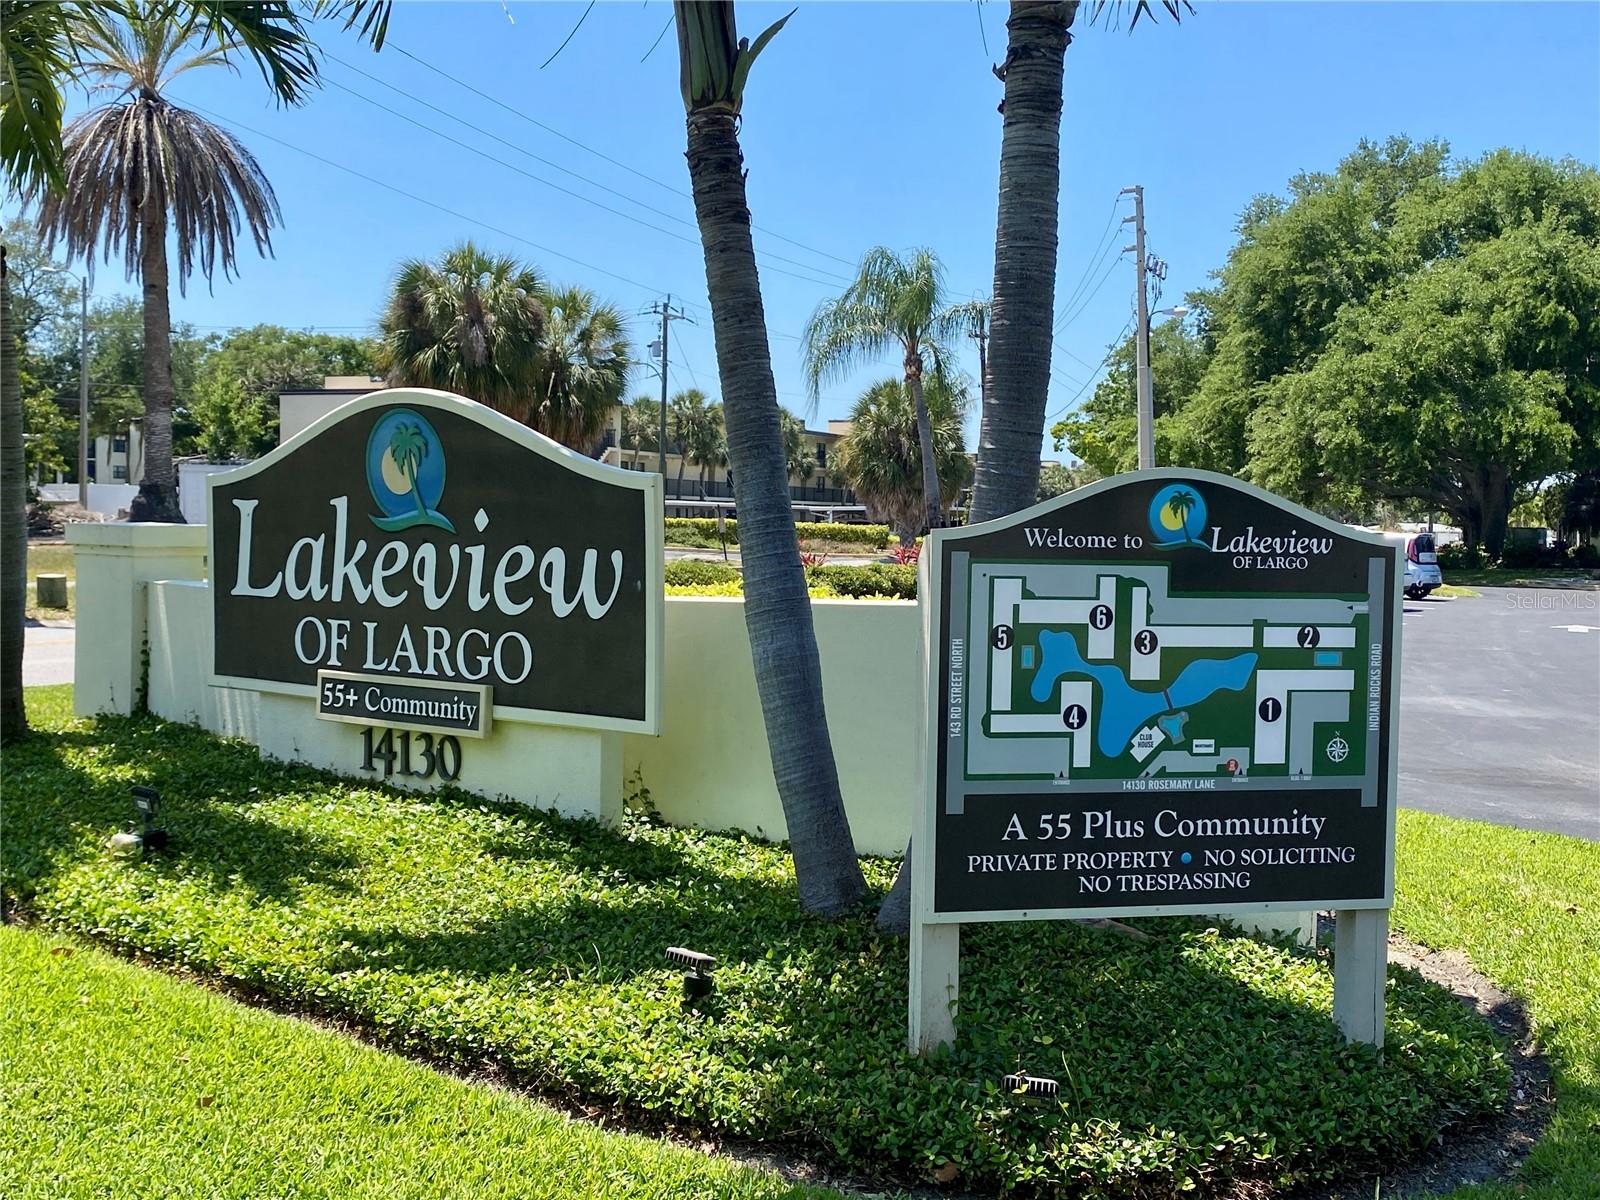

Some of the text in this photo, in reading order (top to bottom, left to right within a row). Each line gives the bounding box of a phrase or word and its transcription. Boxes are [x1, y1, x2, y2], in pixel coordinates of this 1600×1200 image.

[1024, 527, 1143, 550] Welcome to
[1210, 526, 1334, 555] Lakeview
[231, 495, 624, 619] Lakeview
[1232, 555, 1309, 570] OF LARGO
[1096, 606, 1107, 628] 6
[997, 627, 1007, 648] 5
[1140, 632, 1151, 653] 3
[1303, 626, 1314, 648] 2
[294, 616, 533, 685] OF LARGO
[950, 639, 963, 738] 143 RD STREET NORTH
[1368, 643, 1382, 731] INDIAN ROCKS ROAD
[322, 682, 478, 726] 55+ Community
[1266, 699, 1273, 721] 1
[1068, 706, 1079, 728] 4
[360, 728, 462, 781] 14130
[1122, 779, 1216, 790] 14130 ROSEMARY LANE
[1001, 808, 1327, 841] A 55 Plus Community
[967, 846, 1356, 873] PRIVATE PROPERTY NO SOLICITING
[1079, 871, 1251, 894] NO TRESPASSING
